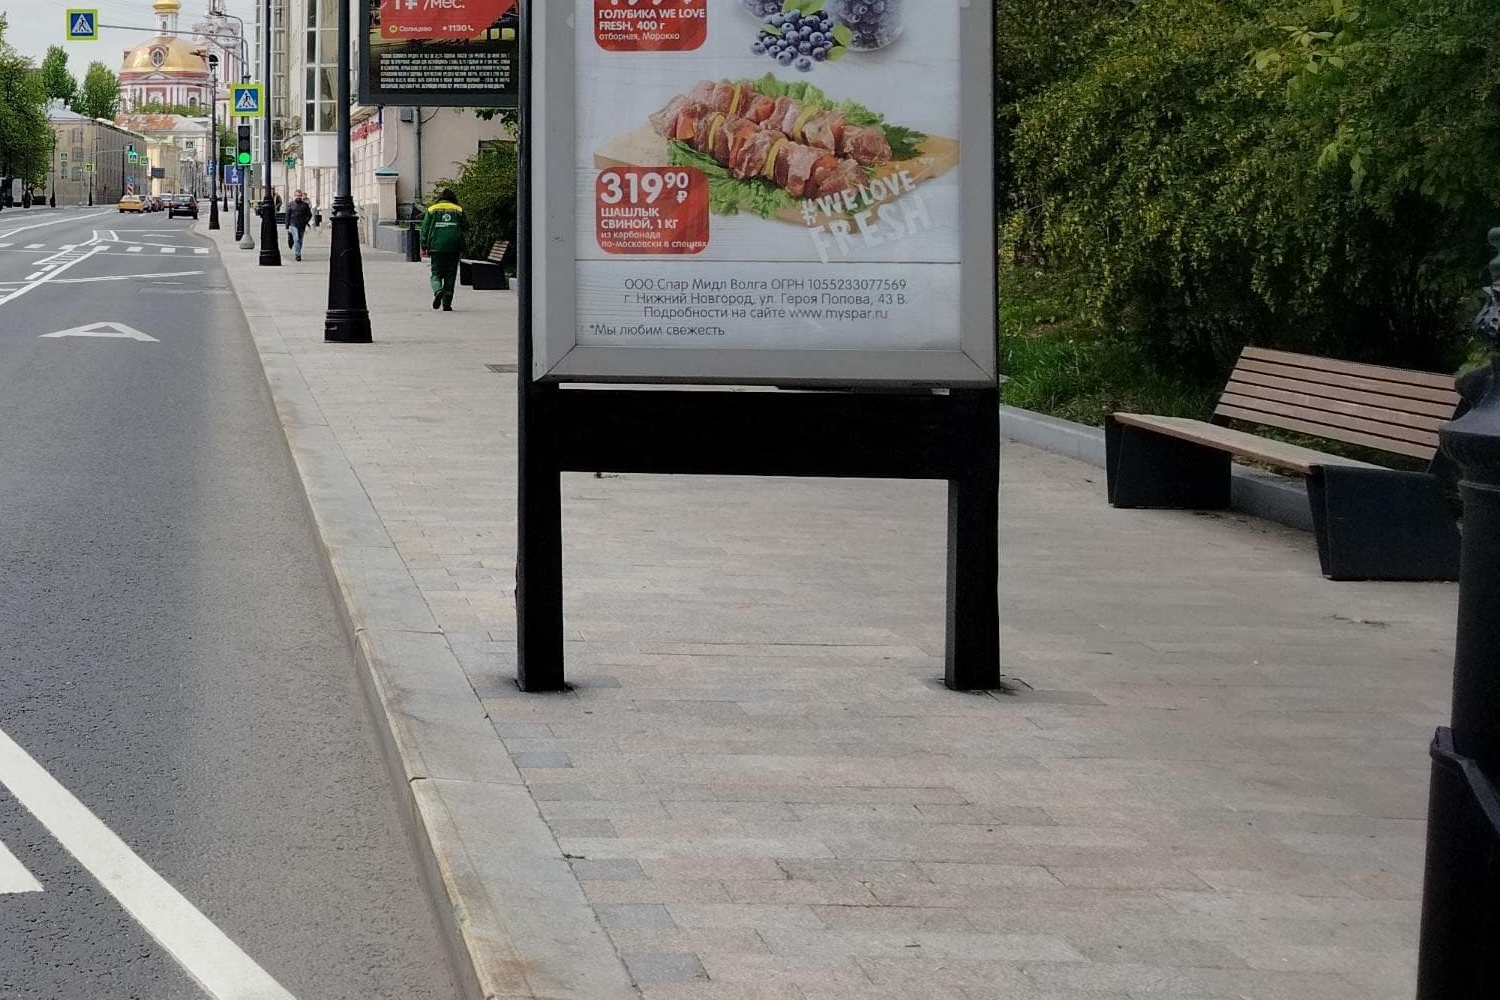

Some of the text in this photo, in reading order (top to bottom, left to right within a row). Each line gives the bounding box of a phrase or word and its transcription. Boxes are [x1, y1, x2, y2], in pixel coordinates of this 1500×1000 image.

[599, 8, 706, 19] ГОЛУБИКА WE LOVE
[599, 20, 666, 31] FRESH, 400 г
[599, 31, 640, 42] отборная,
[858, 169, 916, 206] LOVE
[601, 207, 660, 217] ШАШЛЫК
[601, 217, 679, 230] СВИНОЙ, 1 КГ
[601, 230, 661, 240] из карбонада
[808, 196, 933, 264] FRESH
[624, 278, 907, 291] ООО Спар Мидл Волга ОГРН 1055233077569
[636, 292, 687, 304] Нижний
[690, 293, 755, 306] Новгород,
[759, 295, 777, 306] ул.
[781, 293, 818, 306] Героя
[821, 293, 874, 306] Попова,
[877, 293, 893, 305] 43
[897, 294, 909, 305] В.
[644, 306, 889, 321] Подробности на сайте www.myspar.ru
[620, 325, 663, 336] любим
[666, 326, 725, 336] свежесть
